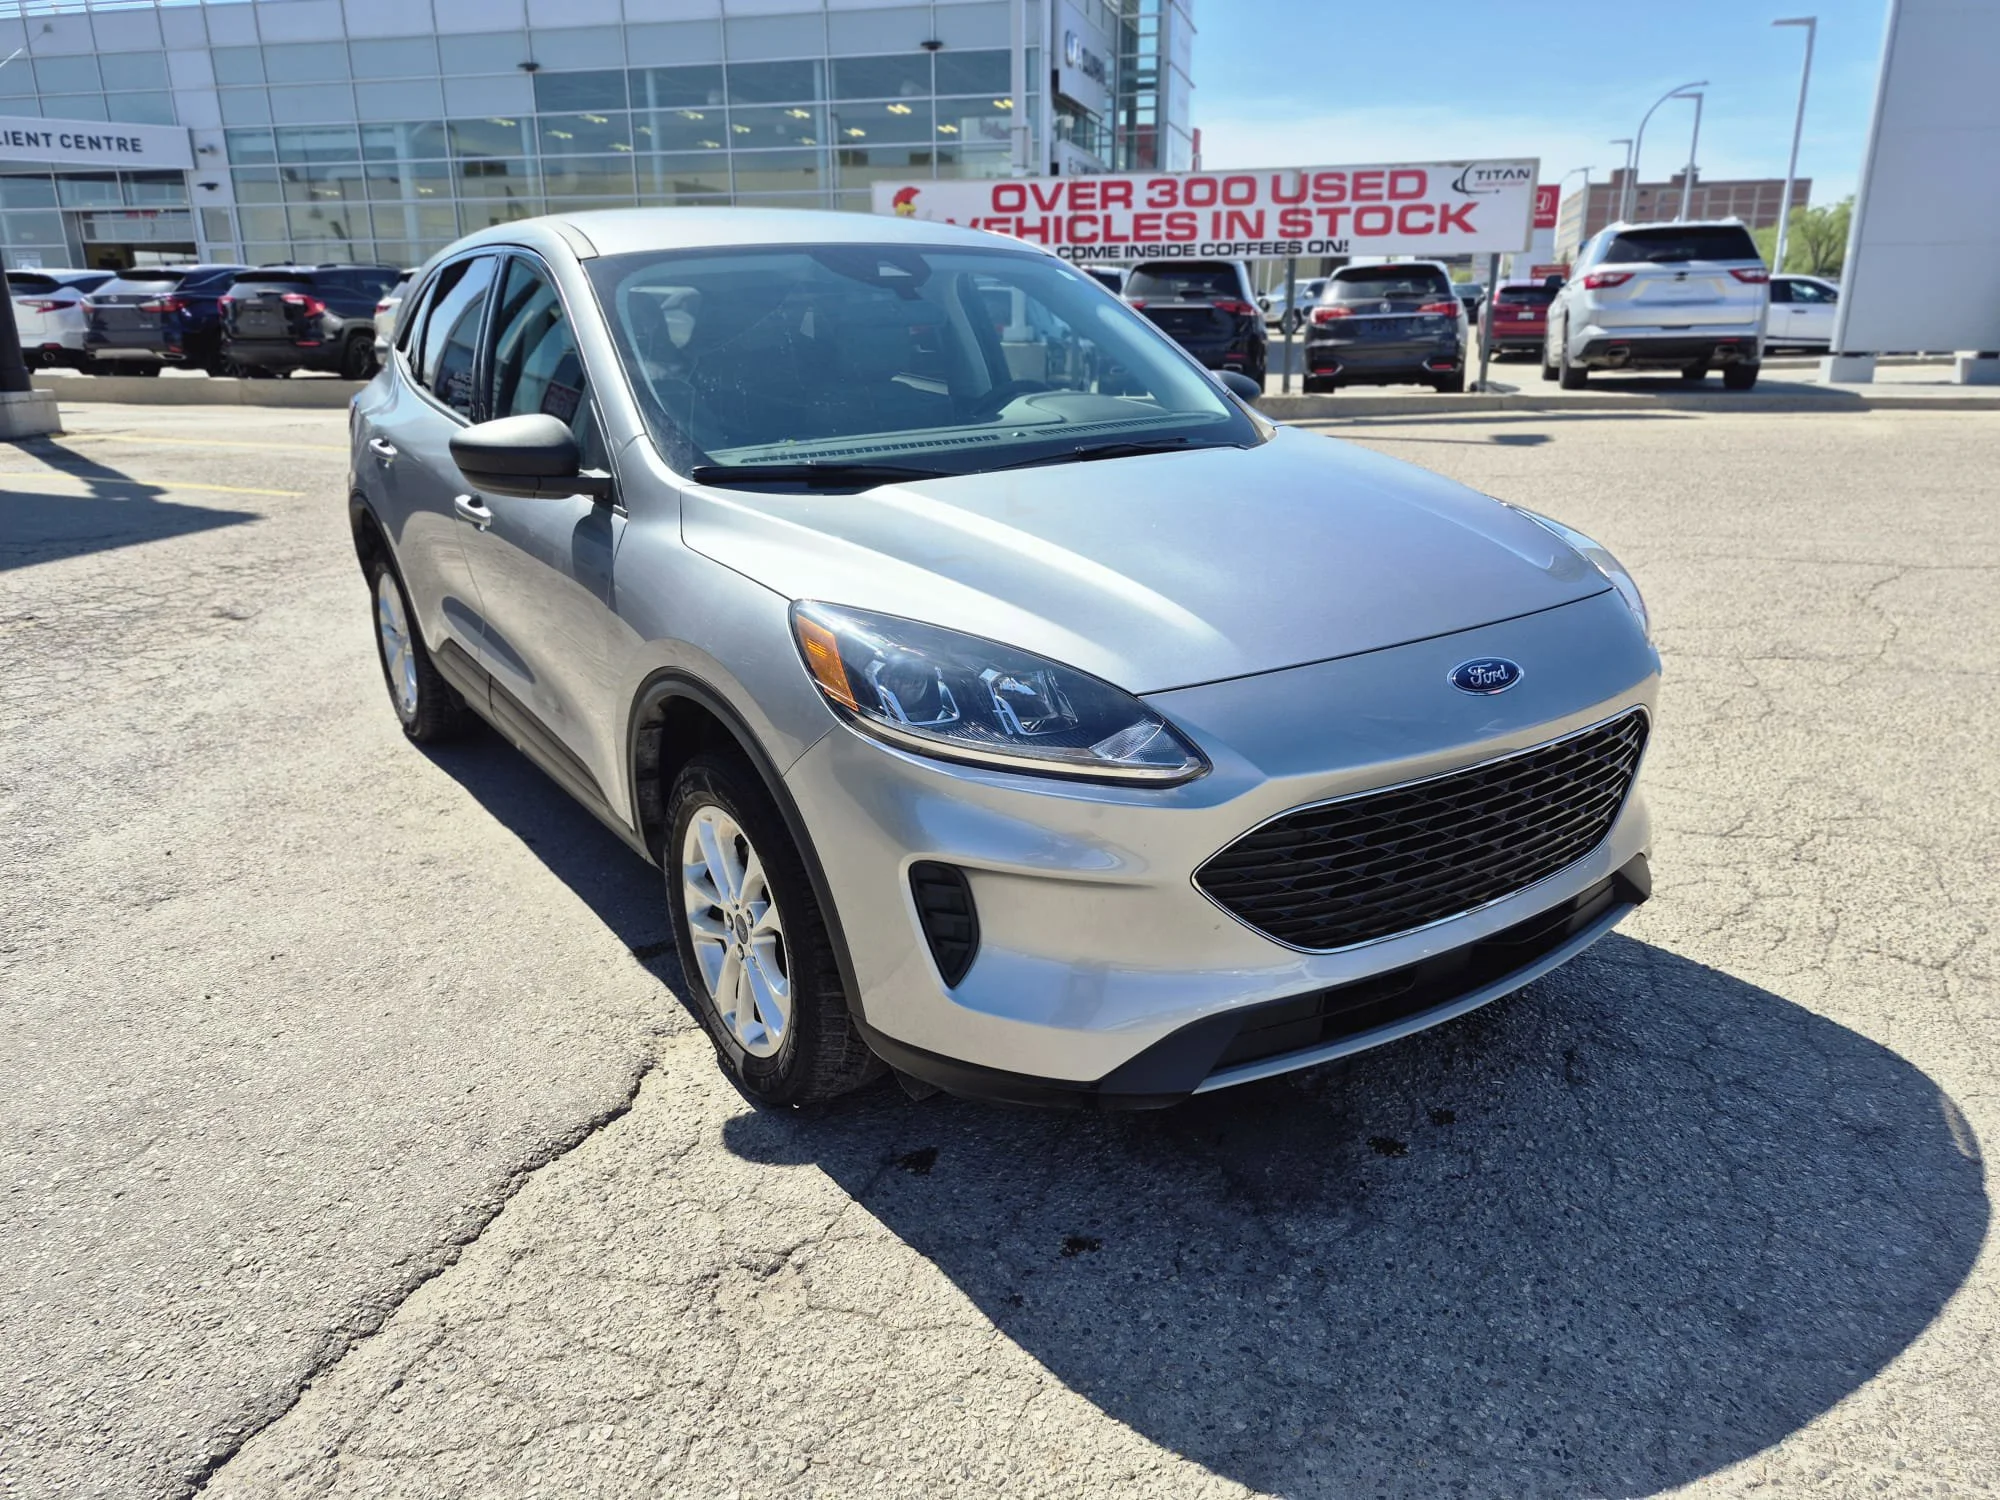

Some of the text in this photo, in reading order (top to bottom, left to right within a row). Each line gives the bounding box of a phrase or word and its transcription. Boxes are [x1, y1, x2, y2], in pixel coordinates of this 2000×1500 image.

[0, 131, 143, 153] IENT CENTRE
[1475, 168, 1531, 180] TITAN
[991, 169, 1428, 213] OVER 300 USED
[1211, 209, 1265, 241] IN
[1278, 202, 1480, 241] STOCK
[1057, 239, 1349, 261] COME INSIDE COFFEES ON!
[1467, 662, 1509, 687] Ford
